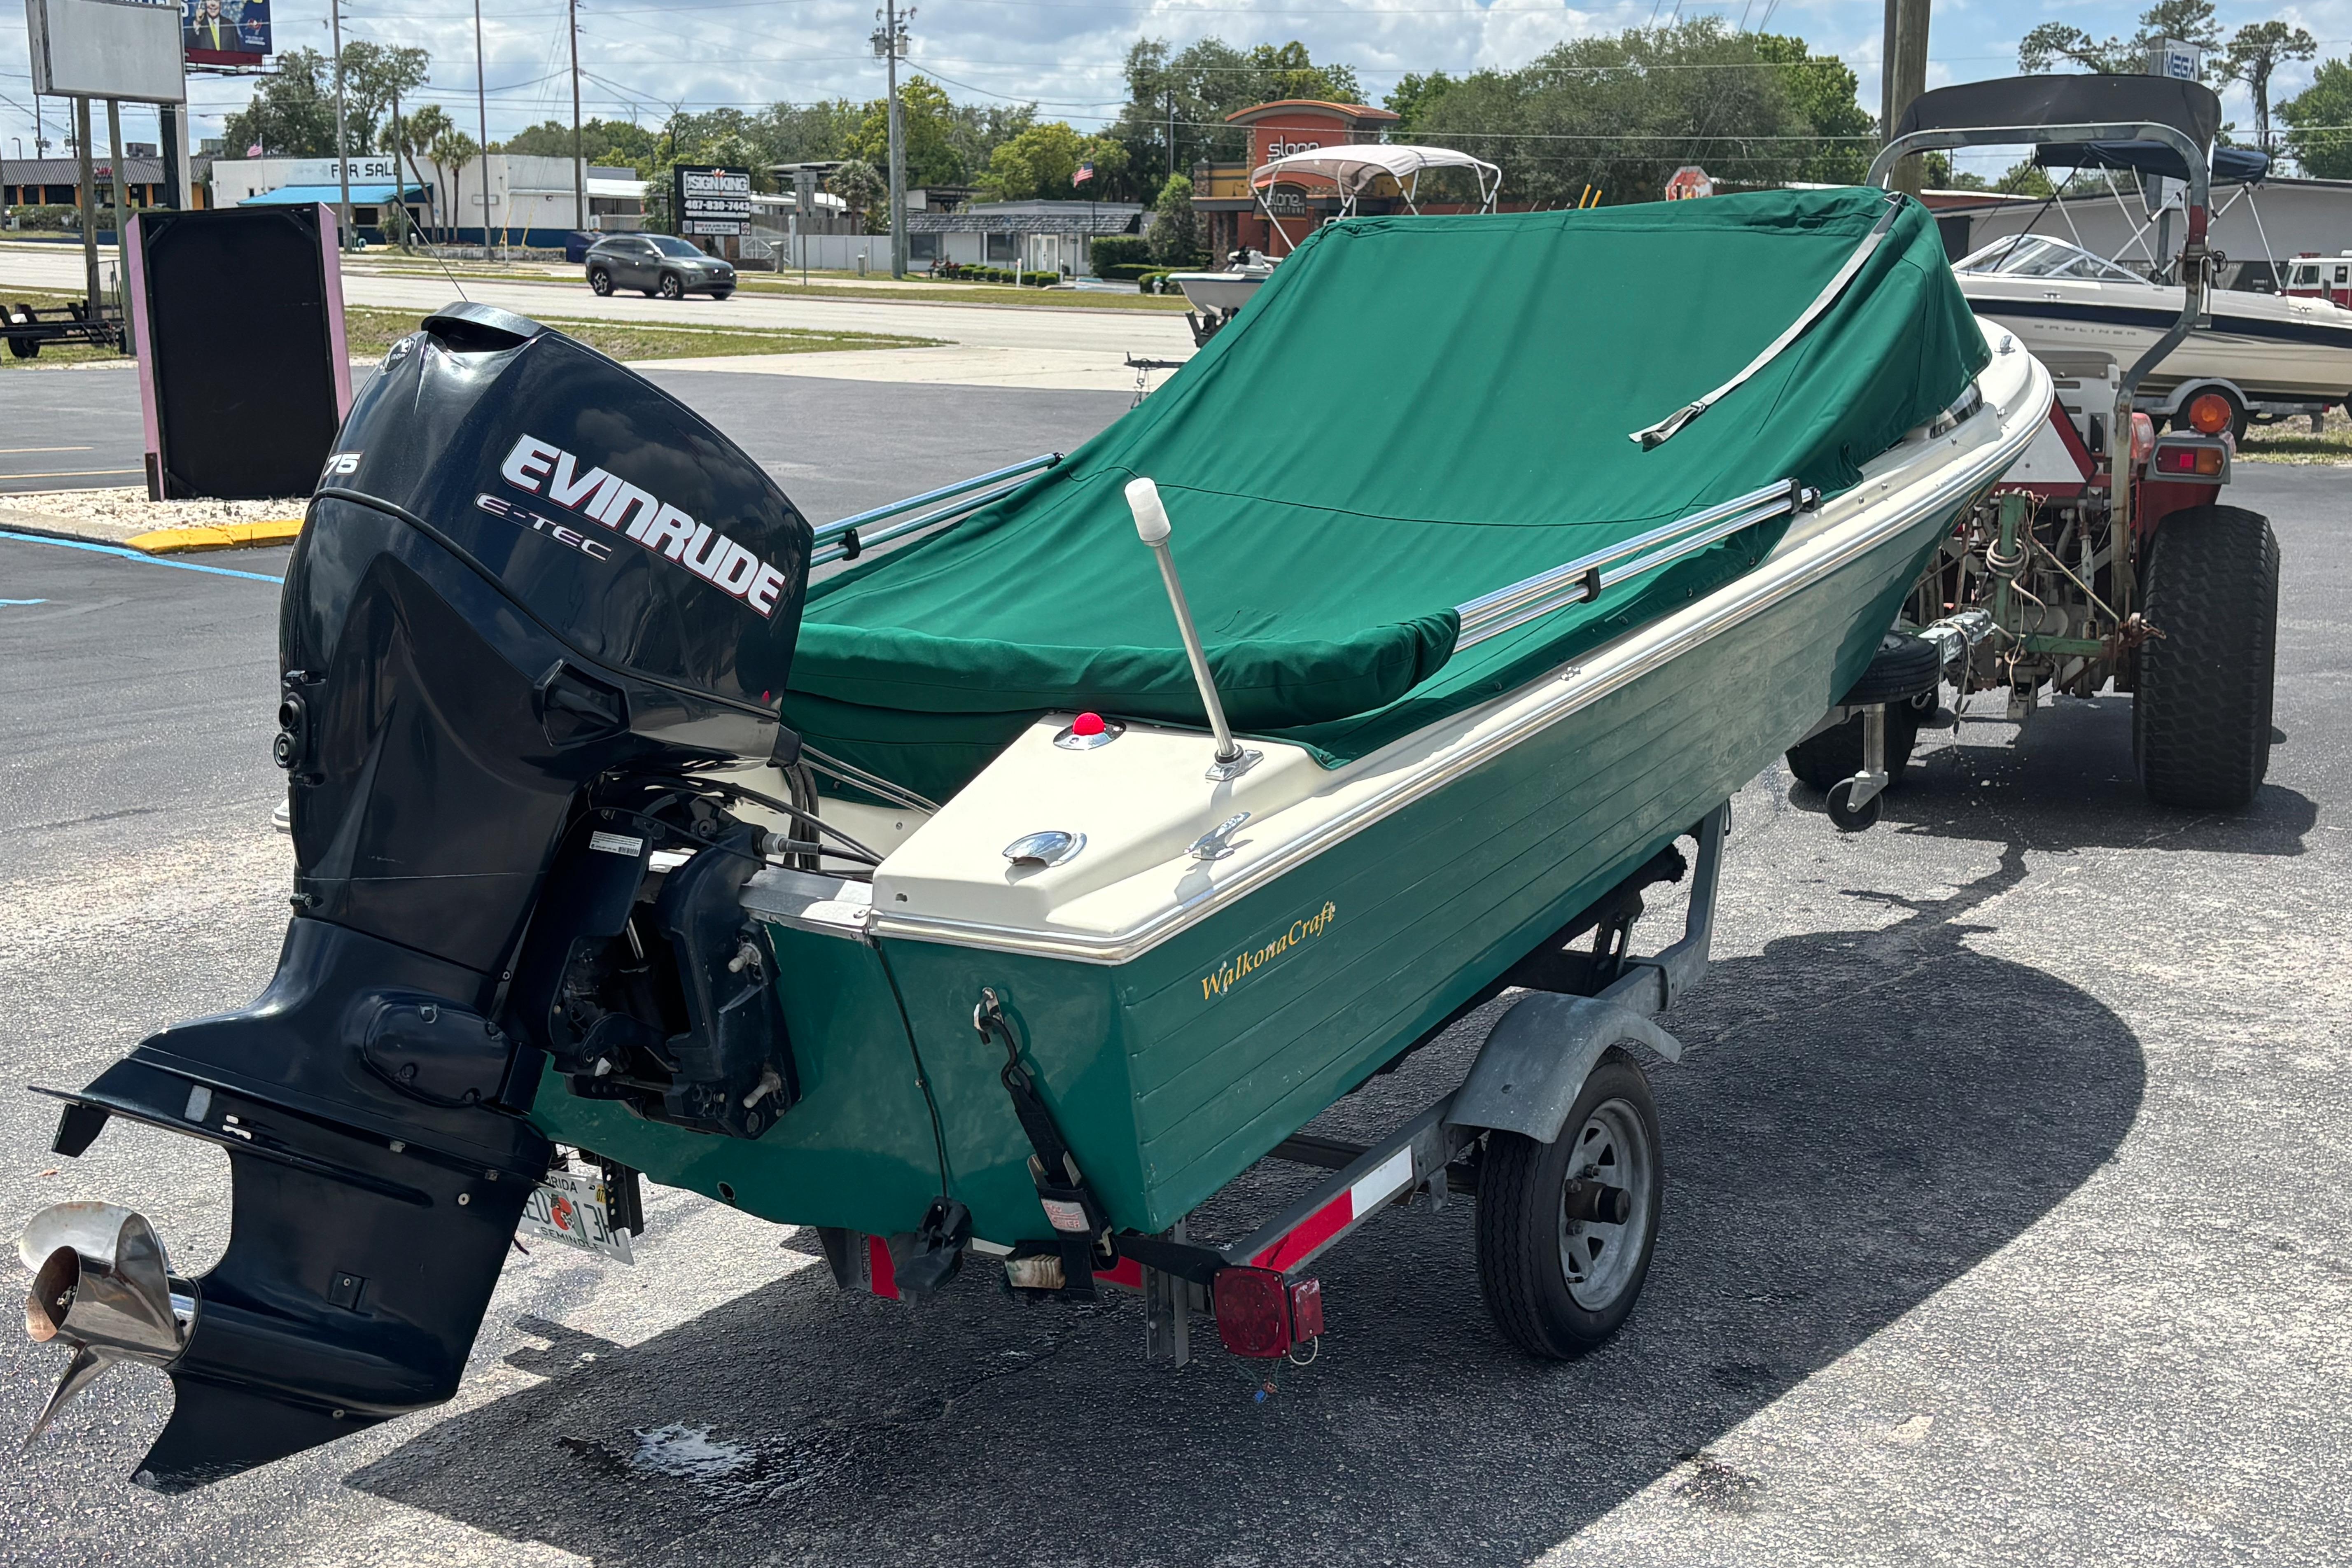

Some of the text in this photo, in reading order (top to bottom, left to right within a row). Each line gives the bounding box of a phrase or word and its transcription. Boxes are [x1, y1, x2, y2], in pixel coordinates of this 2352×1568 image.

[2164, 50, 2195, 80] MEGA
[331, 164, 359, 178] FR
[690, 176, 719, 190] SIGN
[721, 177, 747, 191] KING
[684, 200, 750, 211] 407-830-7443
[2034, 324, 2136, 336] BAYLINER
[324, 453, 361, 476] 75
[476, 494, 612, 561] E-TEC
[501, 433, 786, 616] EVINRUDE
[1201, 900, 1336, 1000] WalkonaCraft
[540, 1226, 602, 1252] SEMINOLE
